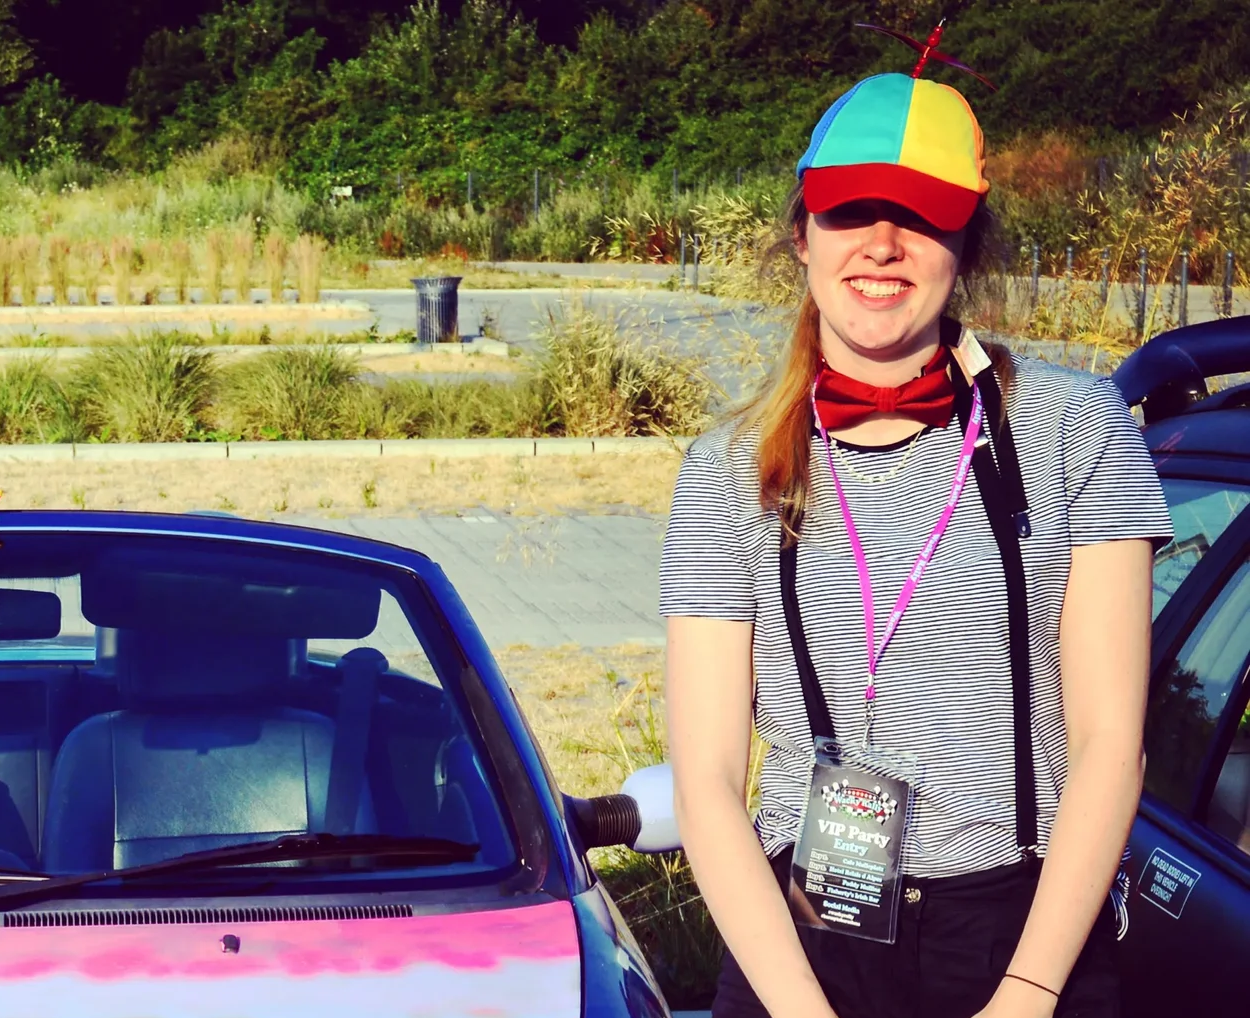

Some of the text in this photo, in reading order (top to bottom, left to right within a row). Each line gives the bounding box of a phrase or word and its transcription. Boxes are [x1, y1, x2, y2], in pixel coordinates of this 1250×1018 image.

[911, 534, 940, 582] Wacky Rally
[818, 819, 891, 848] VIP Party
[833, 838, 869, 857] Entry
